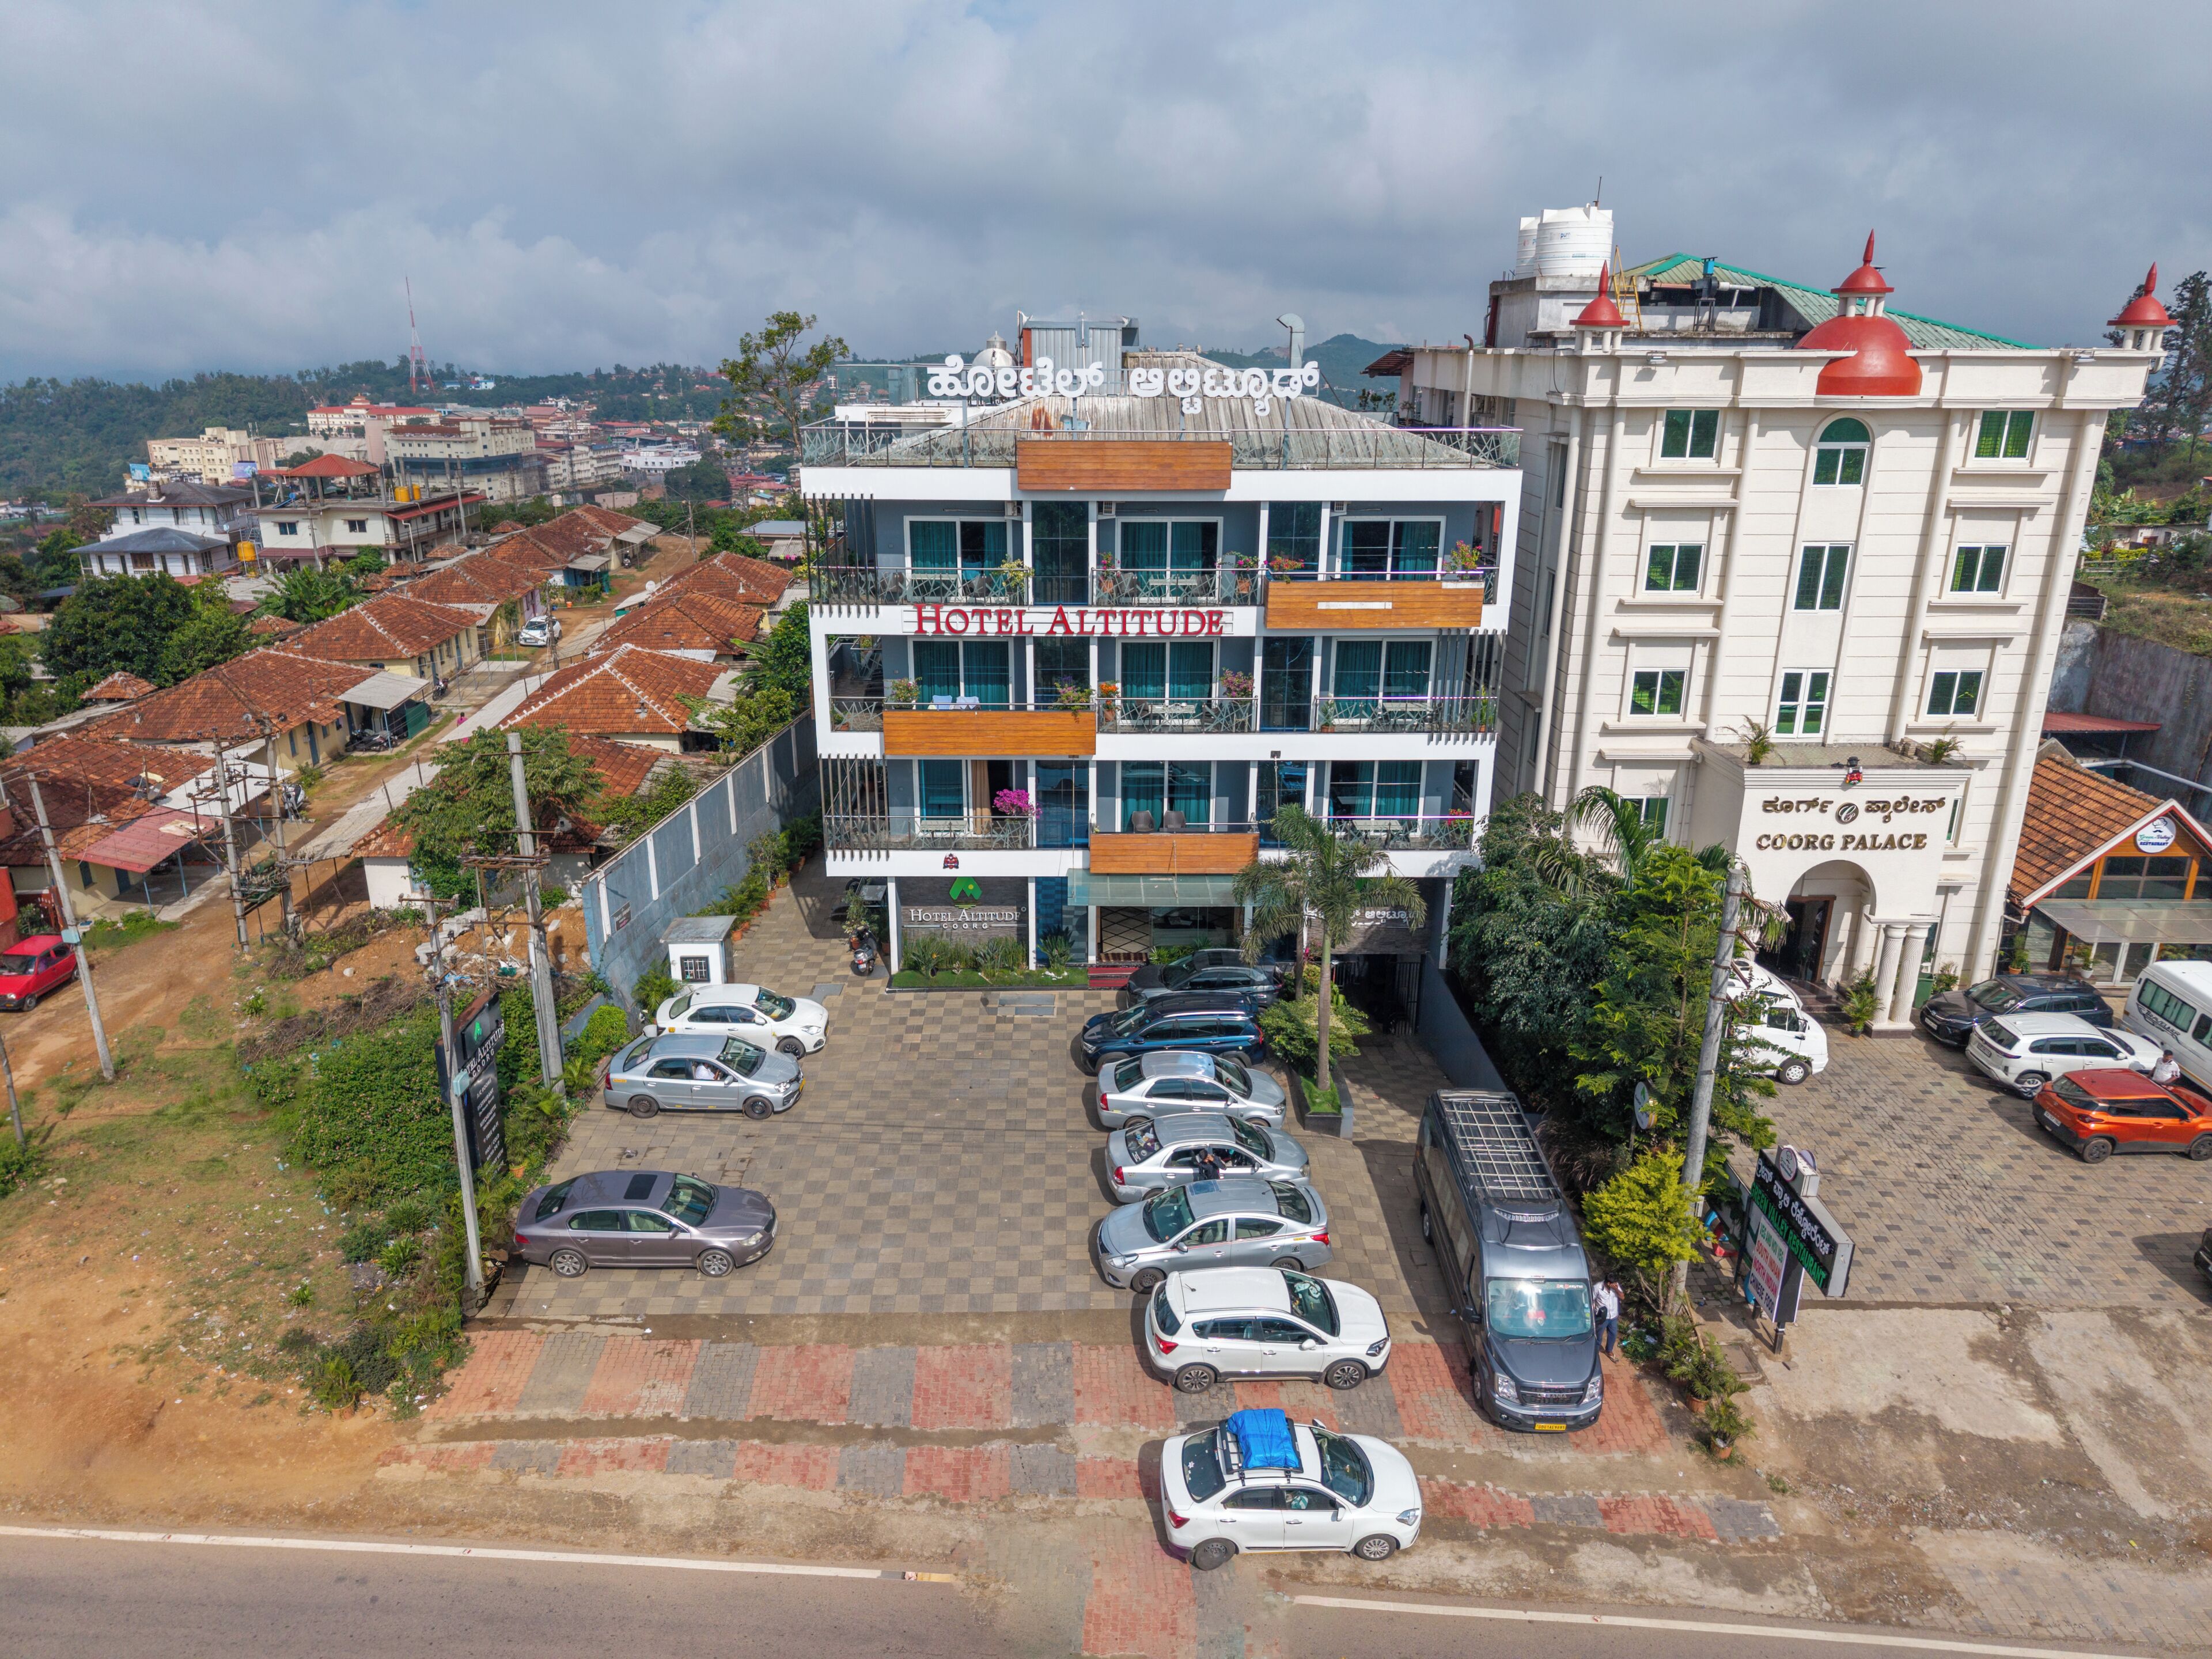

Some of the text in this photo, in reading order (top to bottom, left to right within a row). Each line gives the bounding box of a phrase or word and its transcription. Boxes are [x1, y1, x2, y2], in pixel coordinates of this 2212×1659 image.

[927, 355, 1104, 397] ಹೋಟೆಲ್
[913, 603, 1224, 635] HOTEL ALTITUDE
[1762, 795, 1946, 824] ಕೂರ್ಗ್ ಪ್ಯಾಲೇಸ್
[1756, 833, 1927, 851] COORG PALACE
[910, 908, 1021, 922] HOTEL ALTITUDE
[472, 1048, 494, 1077] COORG
[482, 1078, 492, 1092] ROOMS
[480, 1104, 497, 1128] KITCHENETTE
[1751, 1181, 1768, 1209] GREEN
[1768, 1202, 1789, 1240] VALLEY
[1787, 1228, 1827, 1289] RESTAURANT
[1756, 1240, 1781, 1281] SOUTH INDIAN
[1753, 1256, 1779, 1297] NORTH INDIAN
[1749, 1273, 1774, 1314] CHINESE FOOD
